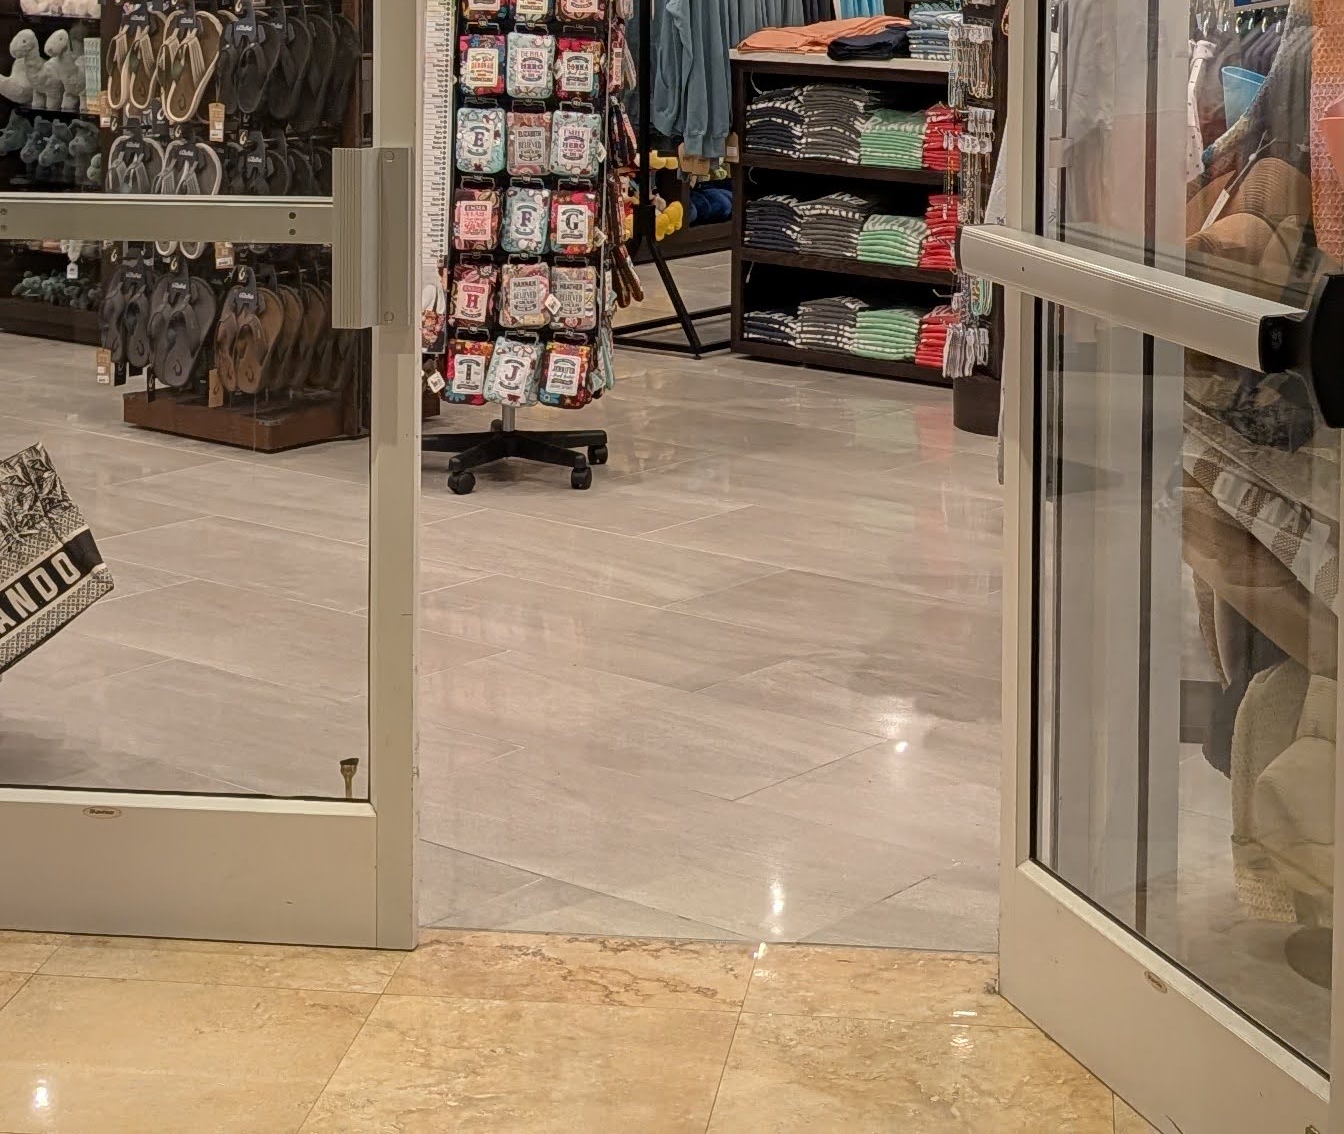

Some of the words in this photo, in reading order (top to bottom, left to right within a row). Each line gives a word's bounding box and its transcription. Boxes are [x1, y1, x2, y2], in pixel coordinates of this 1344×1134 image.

[473, 131, 485, 148] E
[520, 211, 533, 227] F
[565, 213, 579, 230] G
[466, 293, 479, 310] H
[504, 364, 520, 382] J
